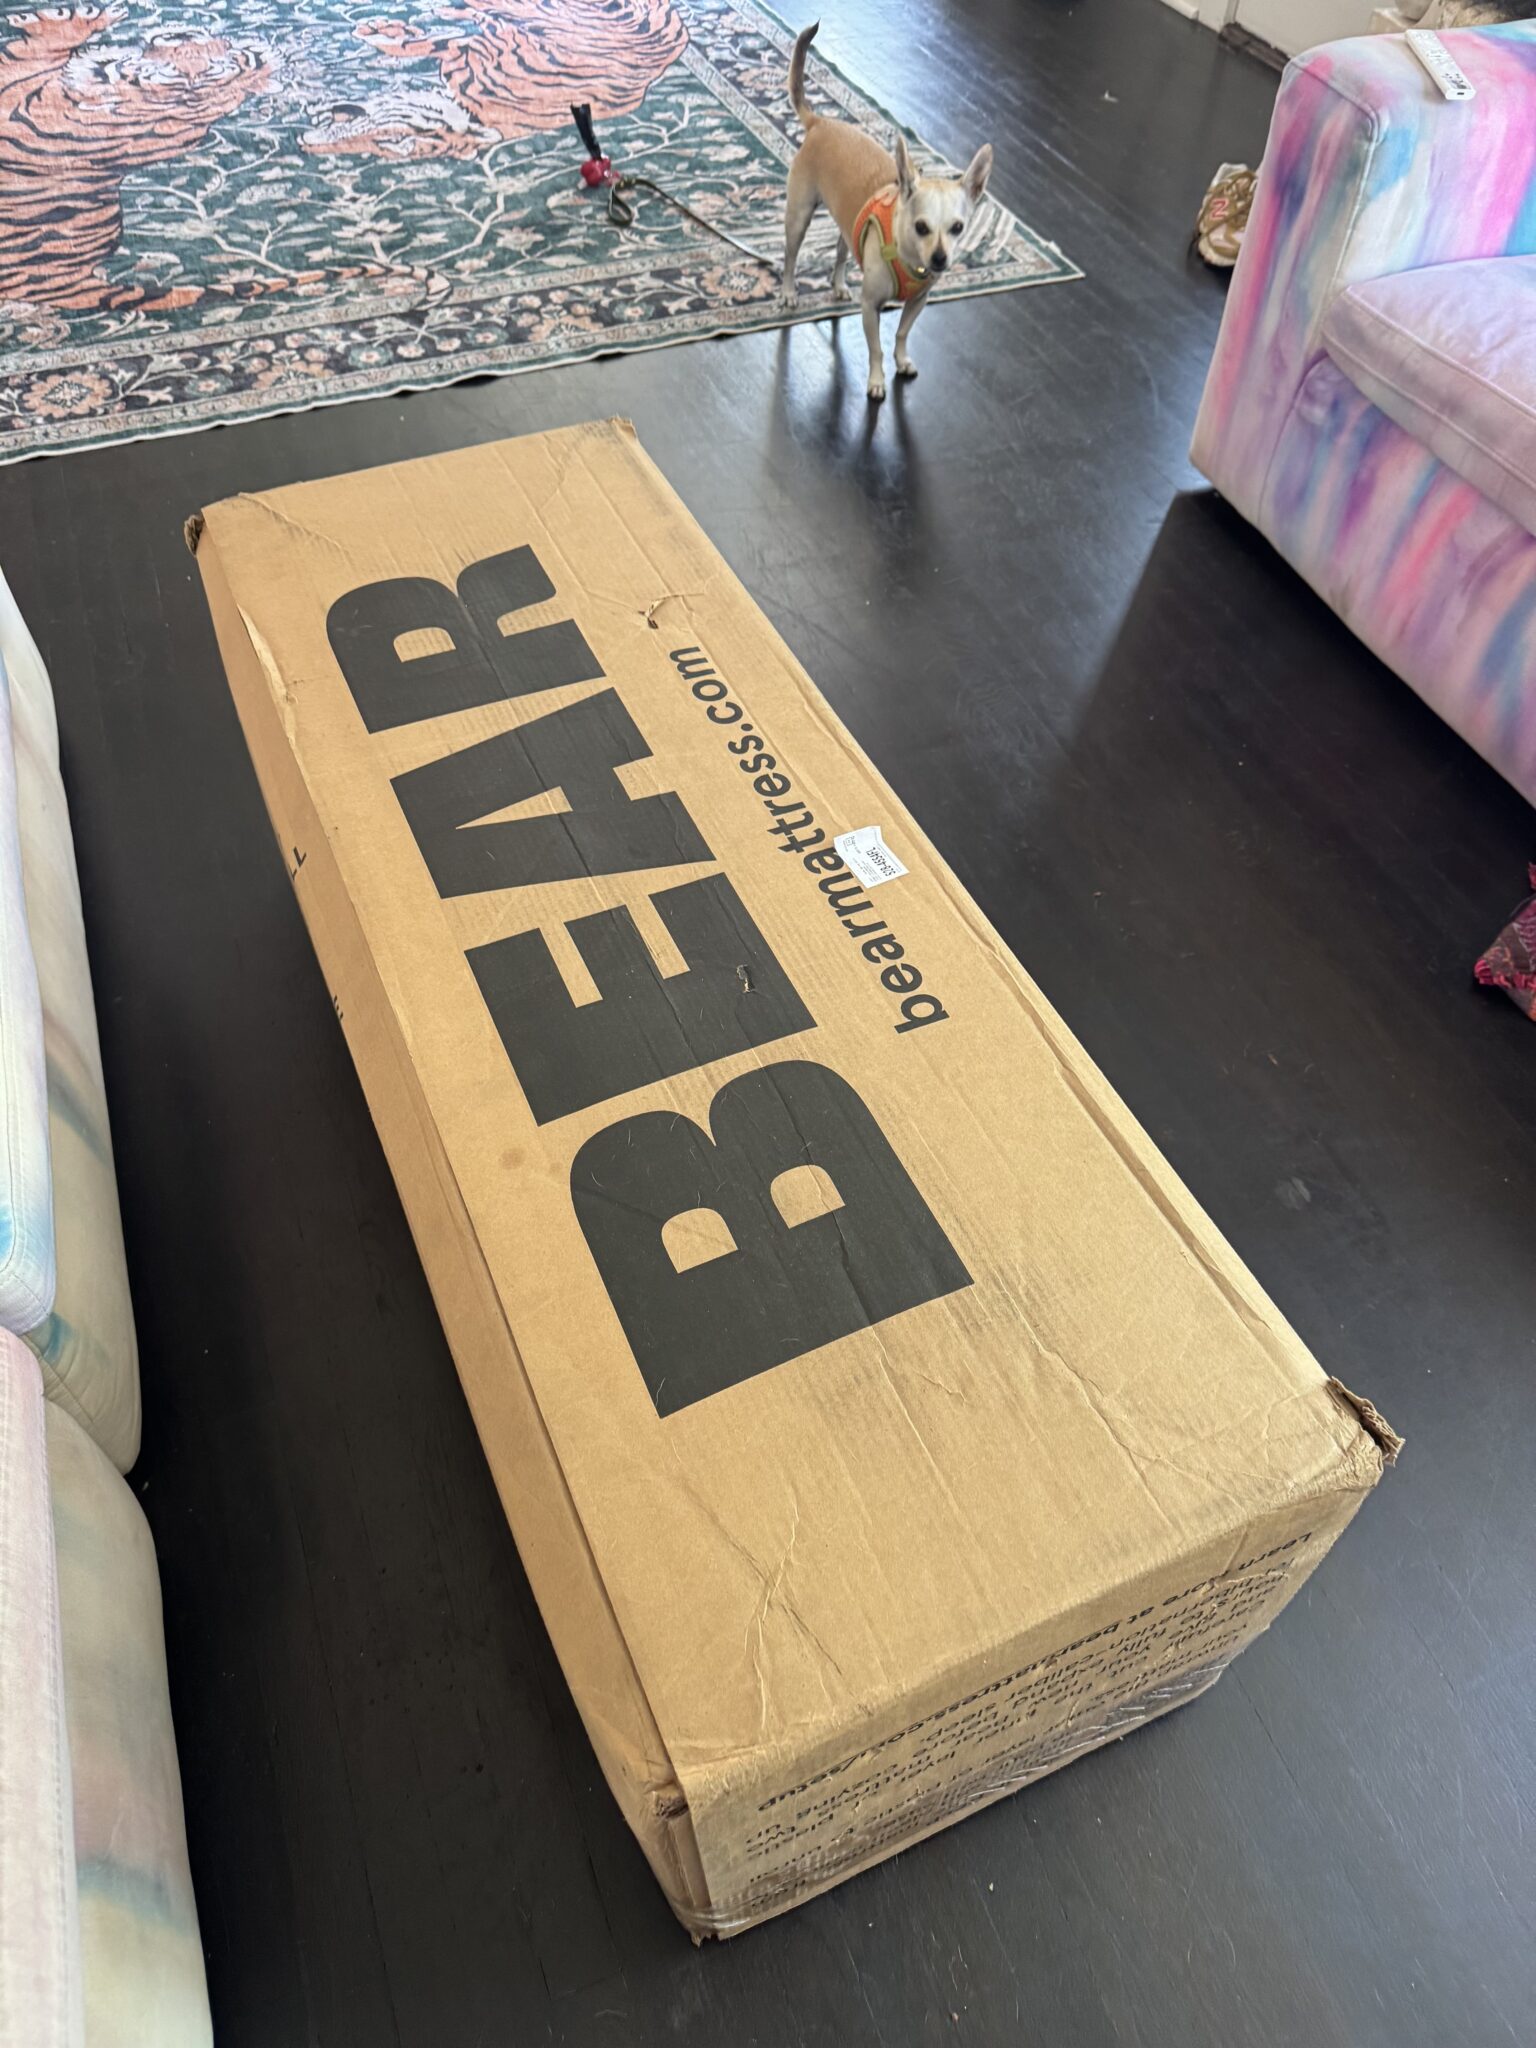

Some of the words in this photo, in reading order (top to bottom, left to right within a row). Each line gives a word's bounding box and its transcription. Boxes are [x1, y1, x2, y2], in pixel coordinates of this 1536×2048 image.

[669, 646, 950, 1034] bearmattress.com
[326, 545, 974, 1418] BEAR
[1233, 1529, 1315, 1576] Learn
[1095, 1641, 1154, 1676] your
[1114, 1623, 1169, 1659] fully
[1010, 1655, 1105, 1711] expand
[1026, 1678, 1080, 1711] new
[910, 1708, 999, 1761] before
[917, 1700, 997, 1748] sleep.
[795, 1761, 898, 1821] cozying
[816, 1753, 931, 1819] mattress
[747, 1812, 834, 1863] plastic
